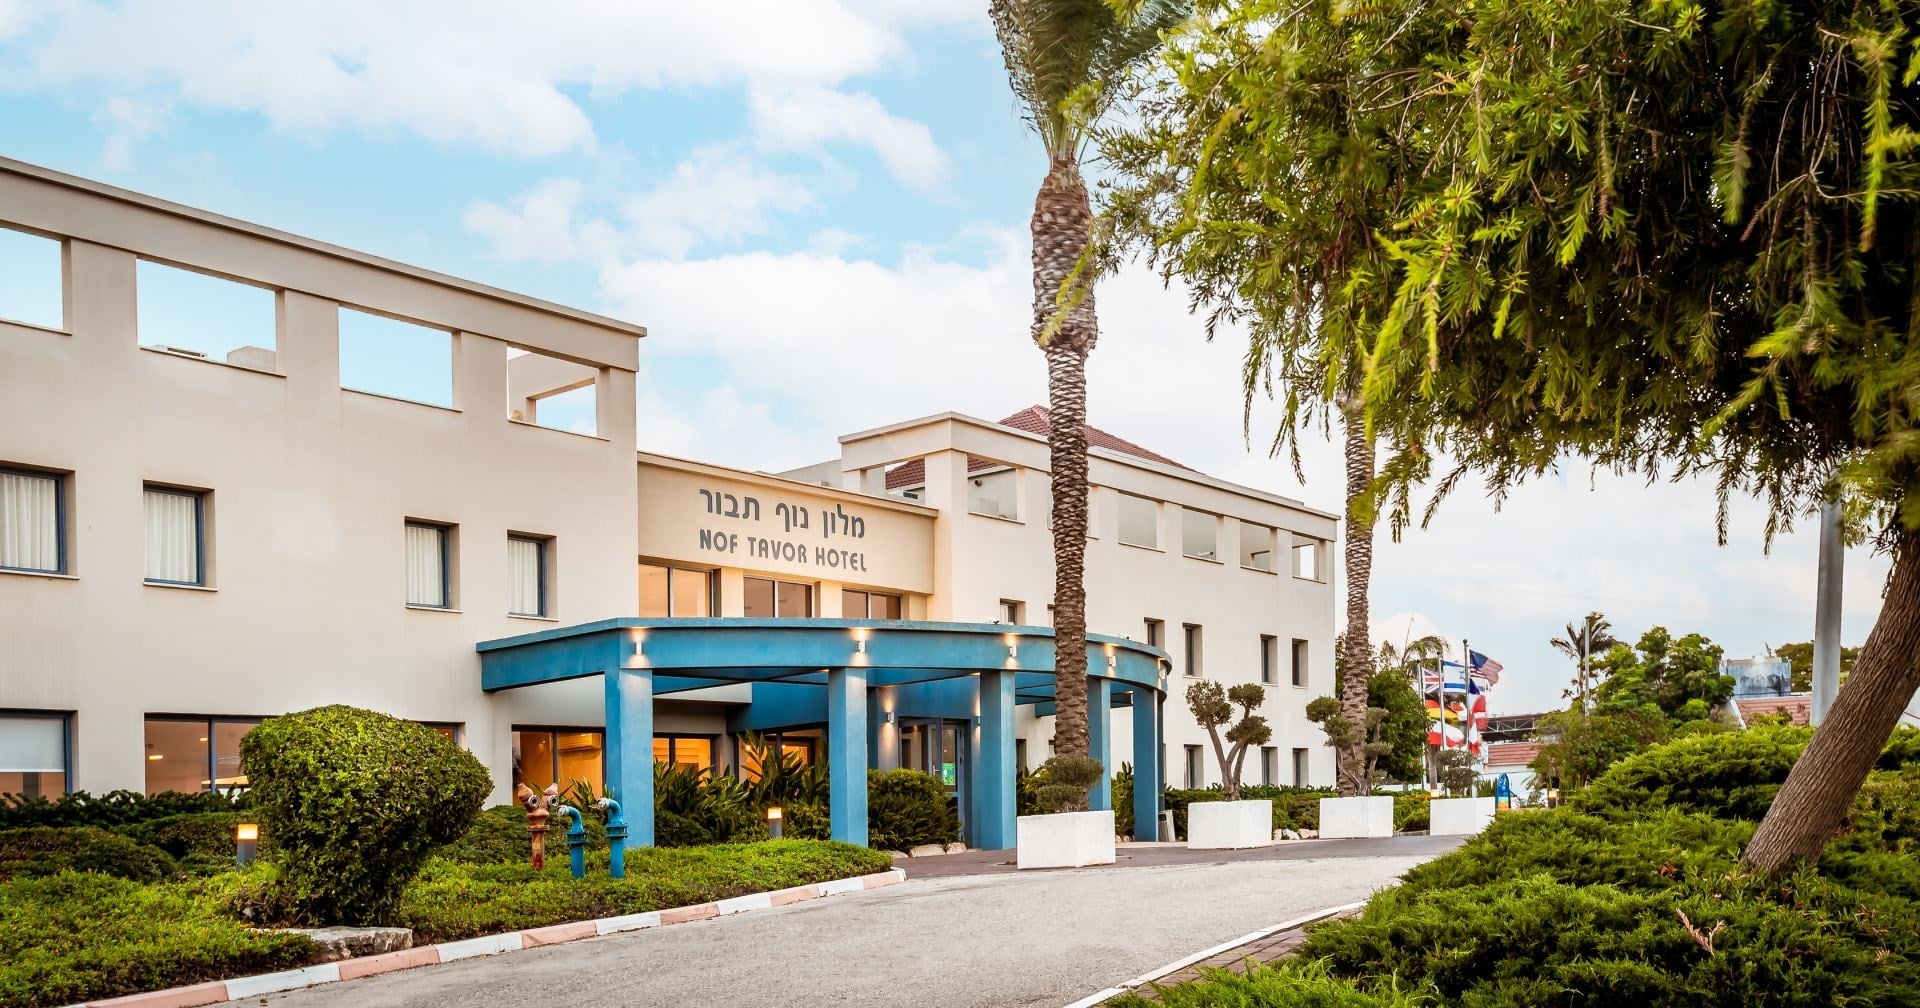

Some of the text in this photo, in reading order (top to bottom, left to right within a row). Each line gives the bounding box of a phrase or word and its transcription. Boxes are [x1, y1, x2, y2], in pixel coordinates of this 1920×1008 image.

[699, 488, 865, 539] מלון נוף תבור
[699, 529, 867, 572] NOF TAVOR HOTEL
